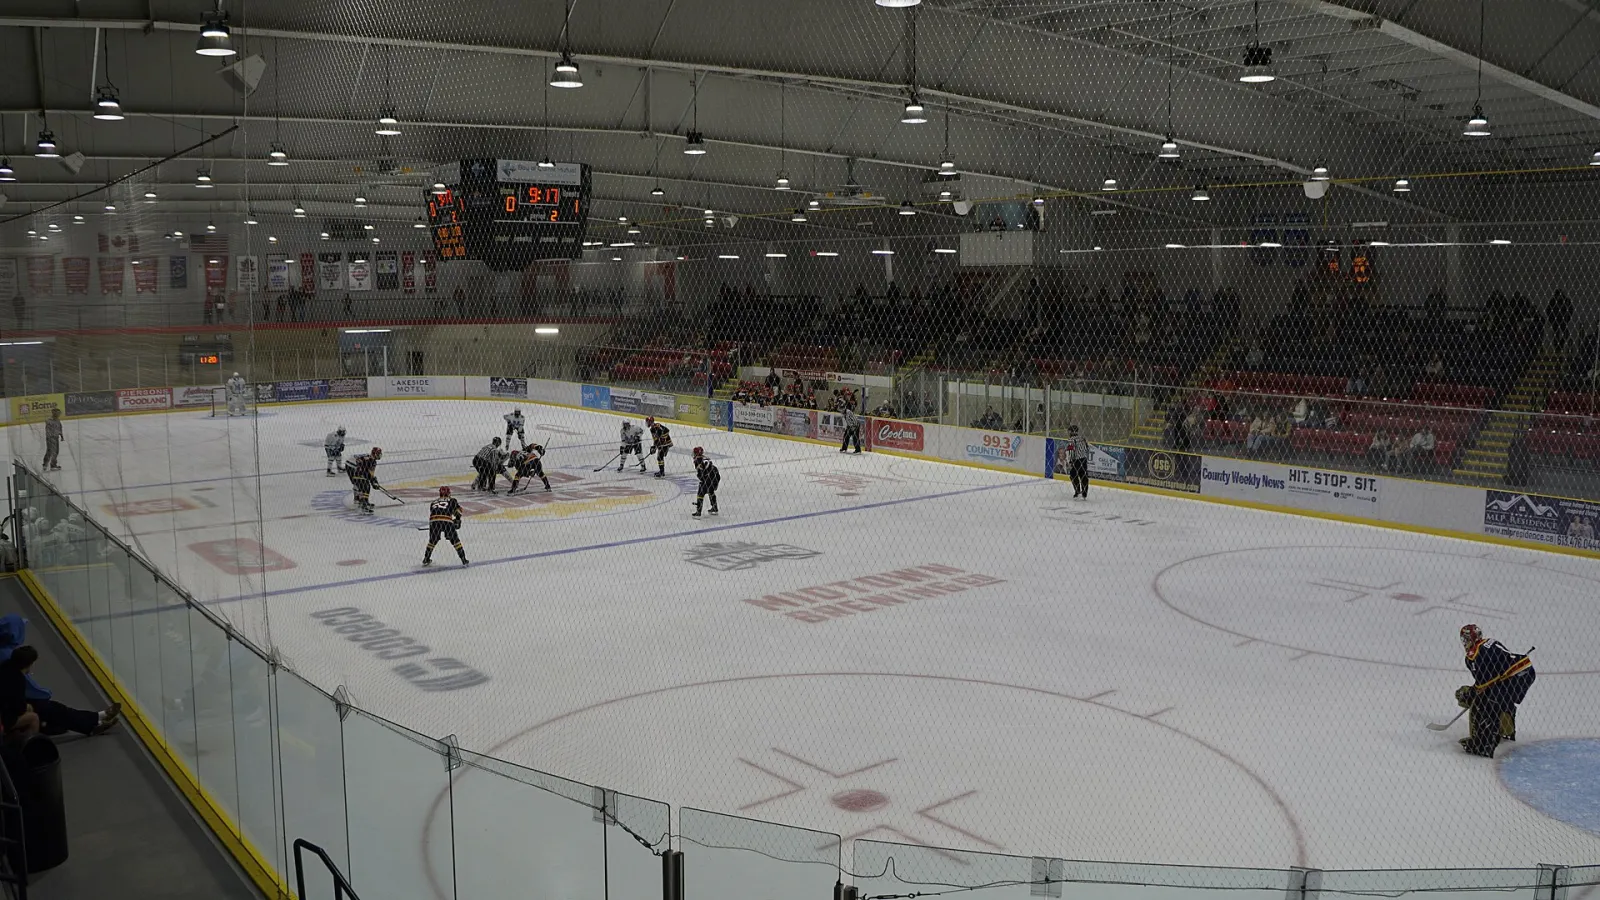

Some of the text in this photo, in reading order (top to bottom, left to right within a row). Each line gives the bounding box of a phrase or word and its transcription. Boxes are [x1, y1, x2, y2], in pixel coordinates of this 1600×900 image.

[529, 187, 558, 203] 9:17
[506, 196, 515, 212] 0
[574, 199, 579, 214] 1
[550, 210, 558, 222] 2
[120, 388, 170, 397] PIERSONS
[123, 396, 167, 405] FOODLAND
[31, 401, 57, 411] Home
[878, 424, 903, 440] Cool
[983, 434, 1010, 449] 99.3
[966, 444, 1014, 458] COUNTYFM
[1154, 459, 1169, 470] OSG
[1202, 467, 1285, 490] County Weekly News
[1289, 469, 1377, 492] HIT. STOP. SIT.
[457, 485, 651, 517] DUKES
[1486, 513, 1558, 530] MLP RESIDENCE
[1484, 526, 1553, 543] www.mlpresidence.ca
[741, 563, 965, 611] MIDTOWN
[784, 580, 969, 623] BREWING
